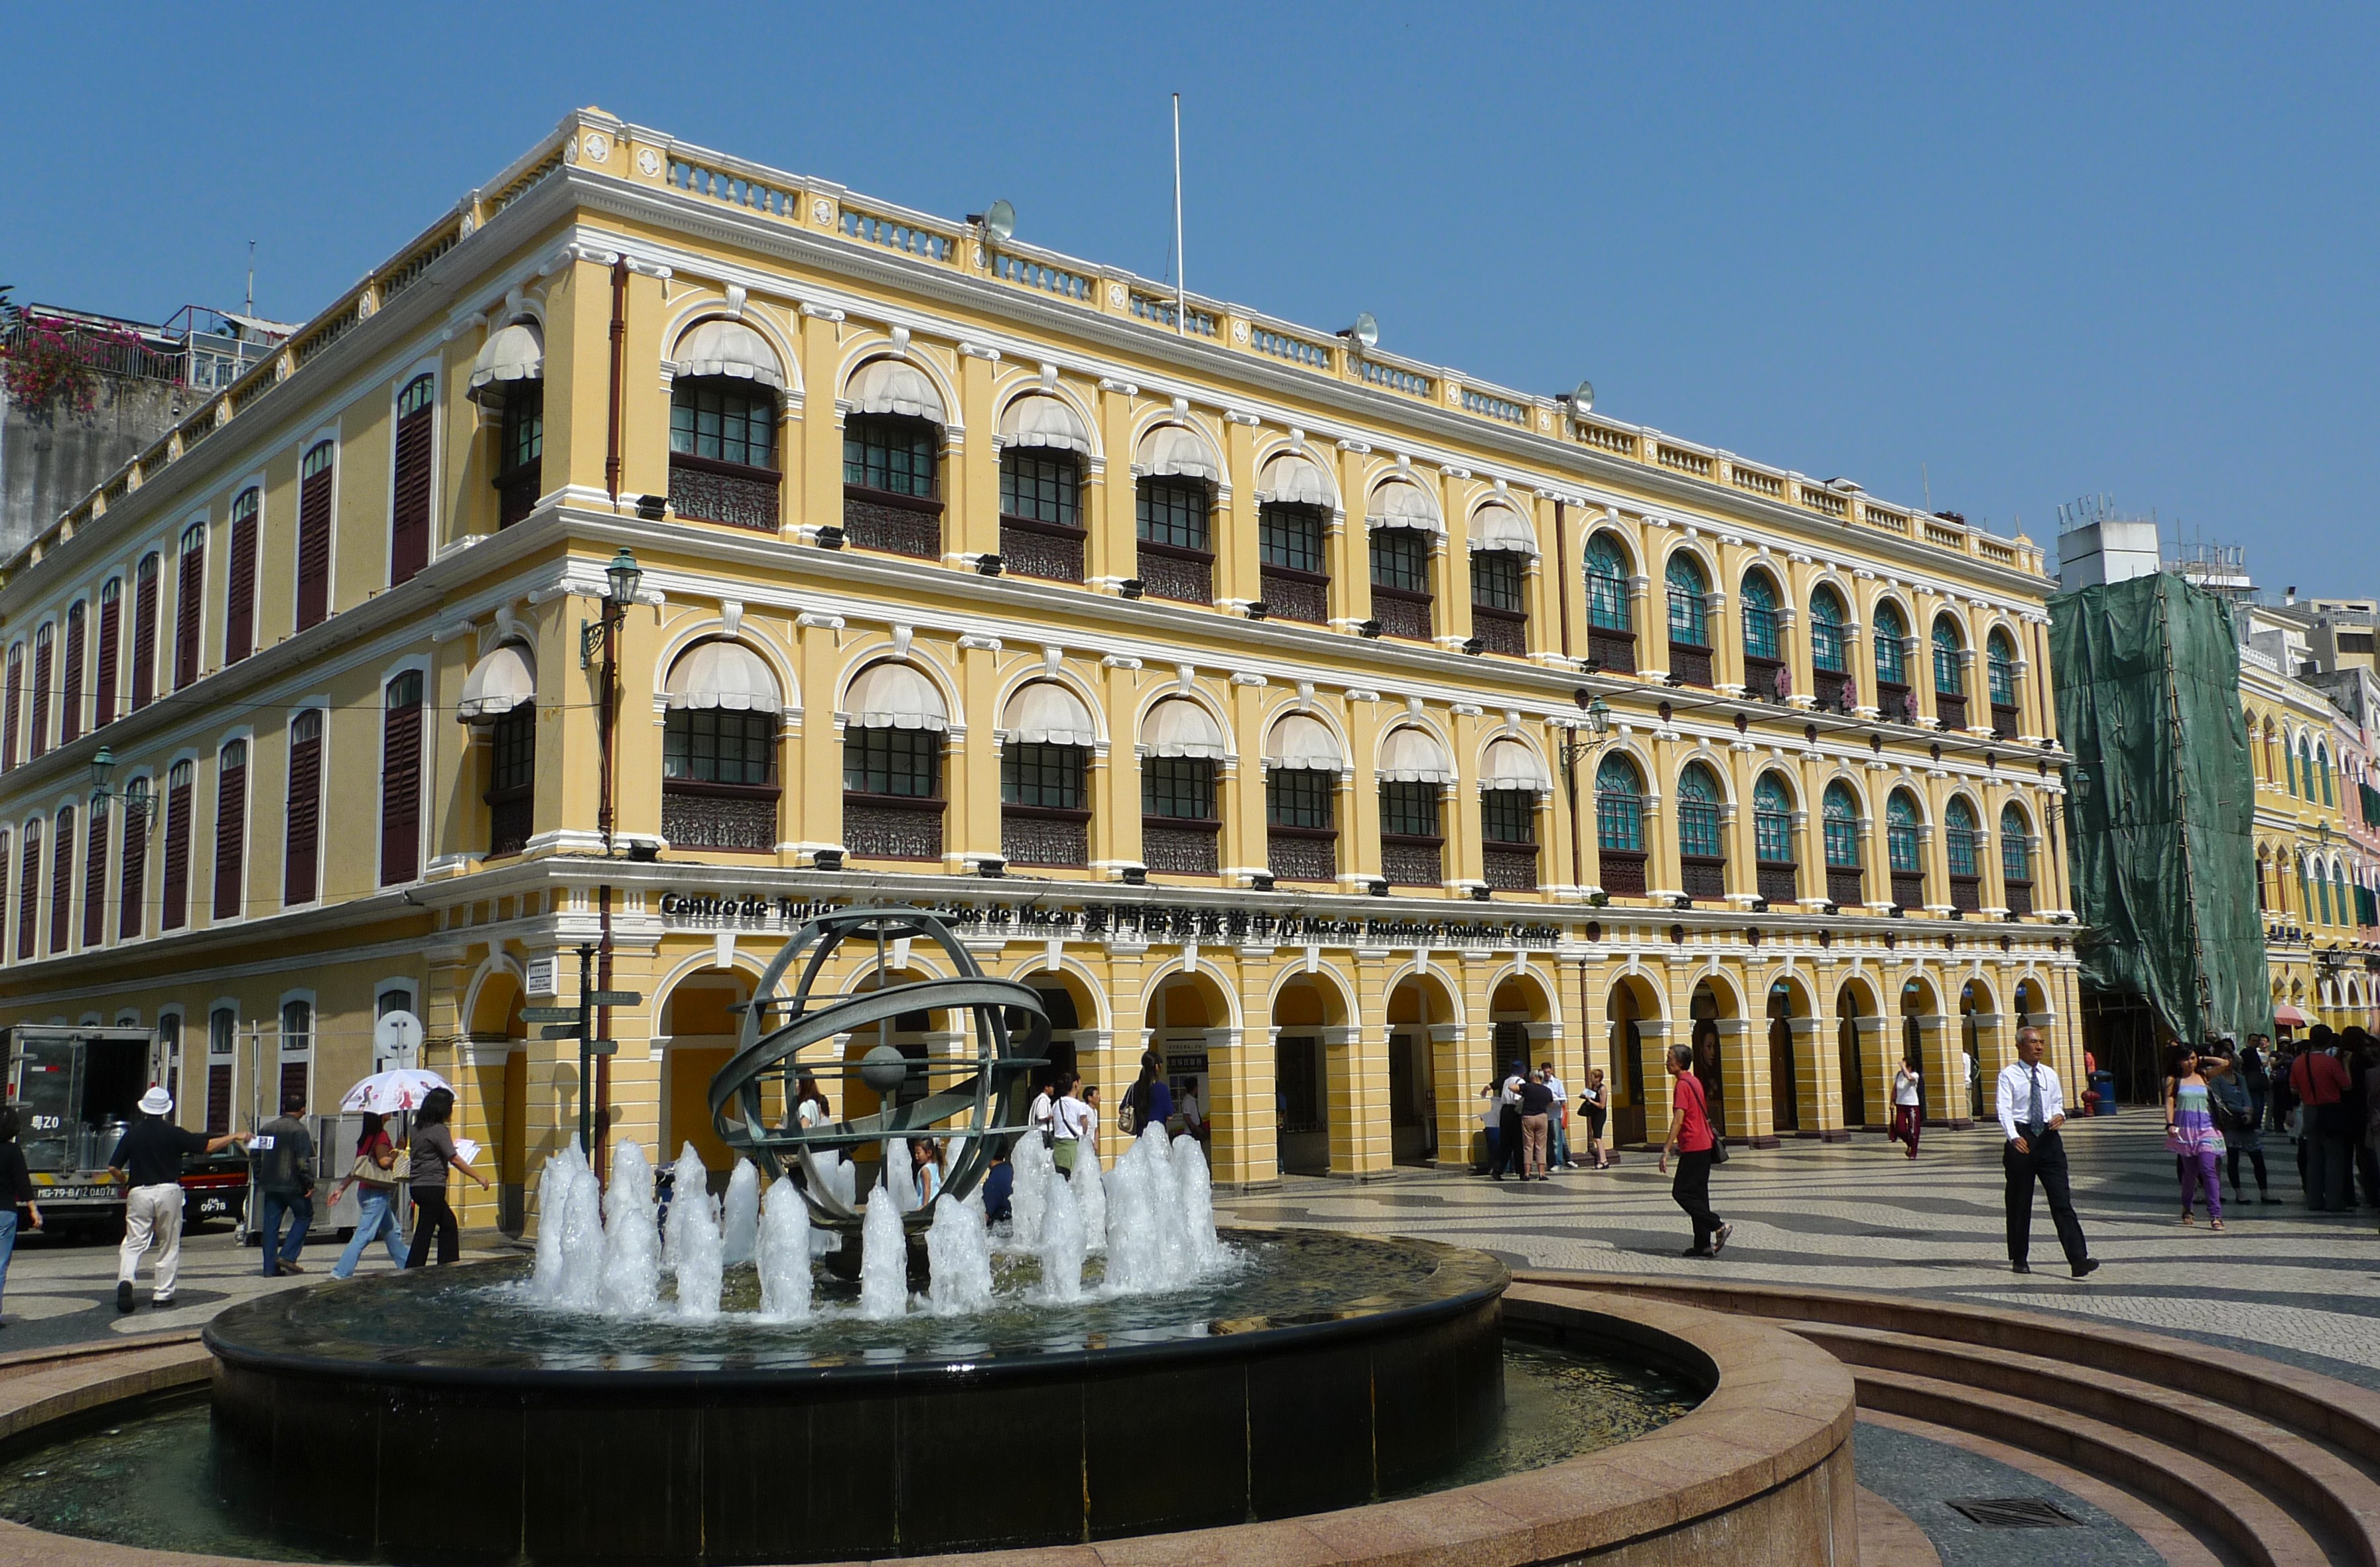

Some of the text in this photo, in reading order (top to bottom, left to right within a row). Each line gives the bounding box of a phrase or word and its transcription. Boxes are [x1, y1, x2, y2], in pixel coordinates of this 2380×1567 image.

[661, 893, 738, 916] Centro
[741, 895, 767, 917] de
[777, 898, 849, 918] Turis
[986, 903, 1011, 923] de
[1019, 905, 1075, 926] Macau
[1084, 905, 1297, 938] 澳門商務旅遊中心
[1302, 917, 1561, 940] Macau Business Tourism Centre
